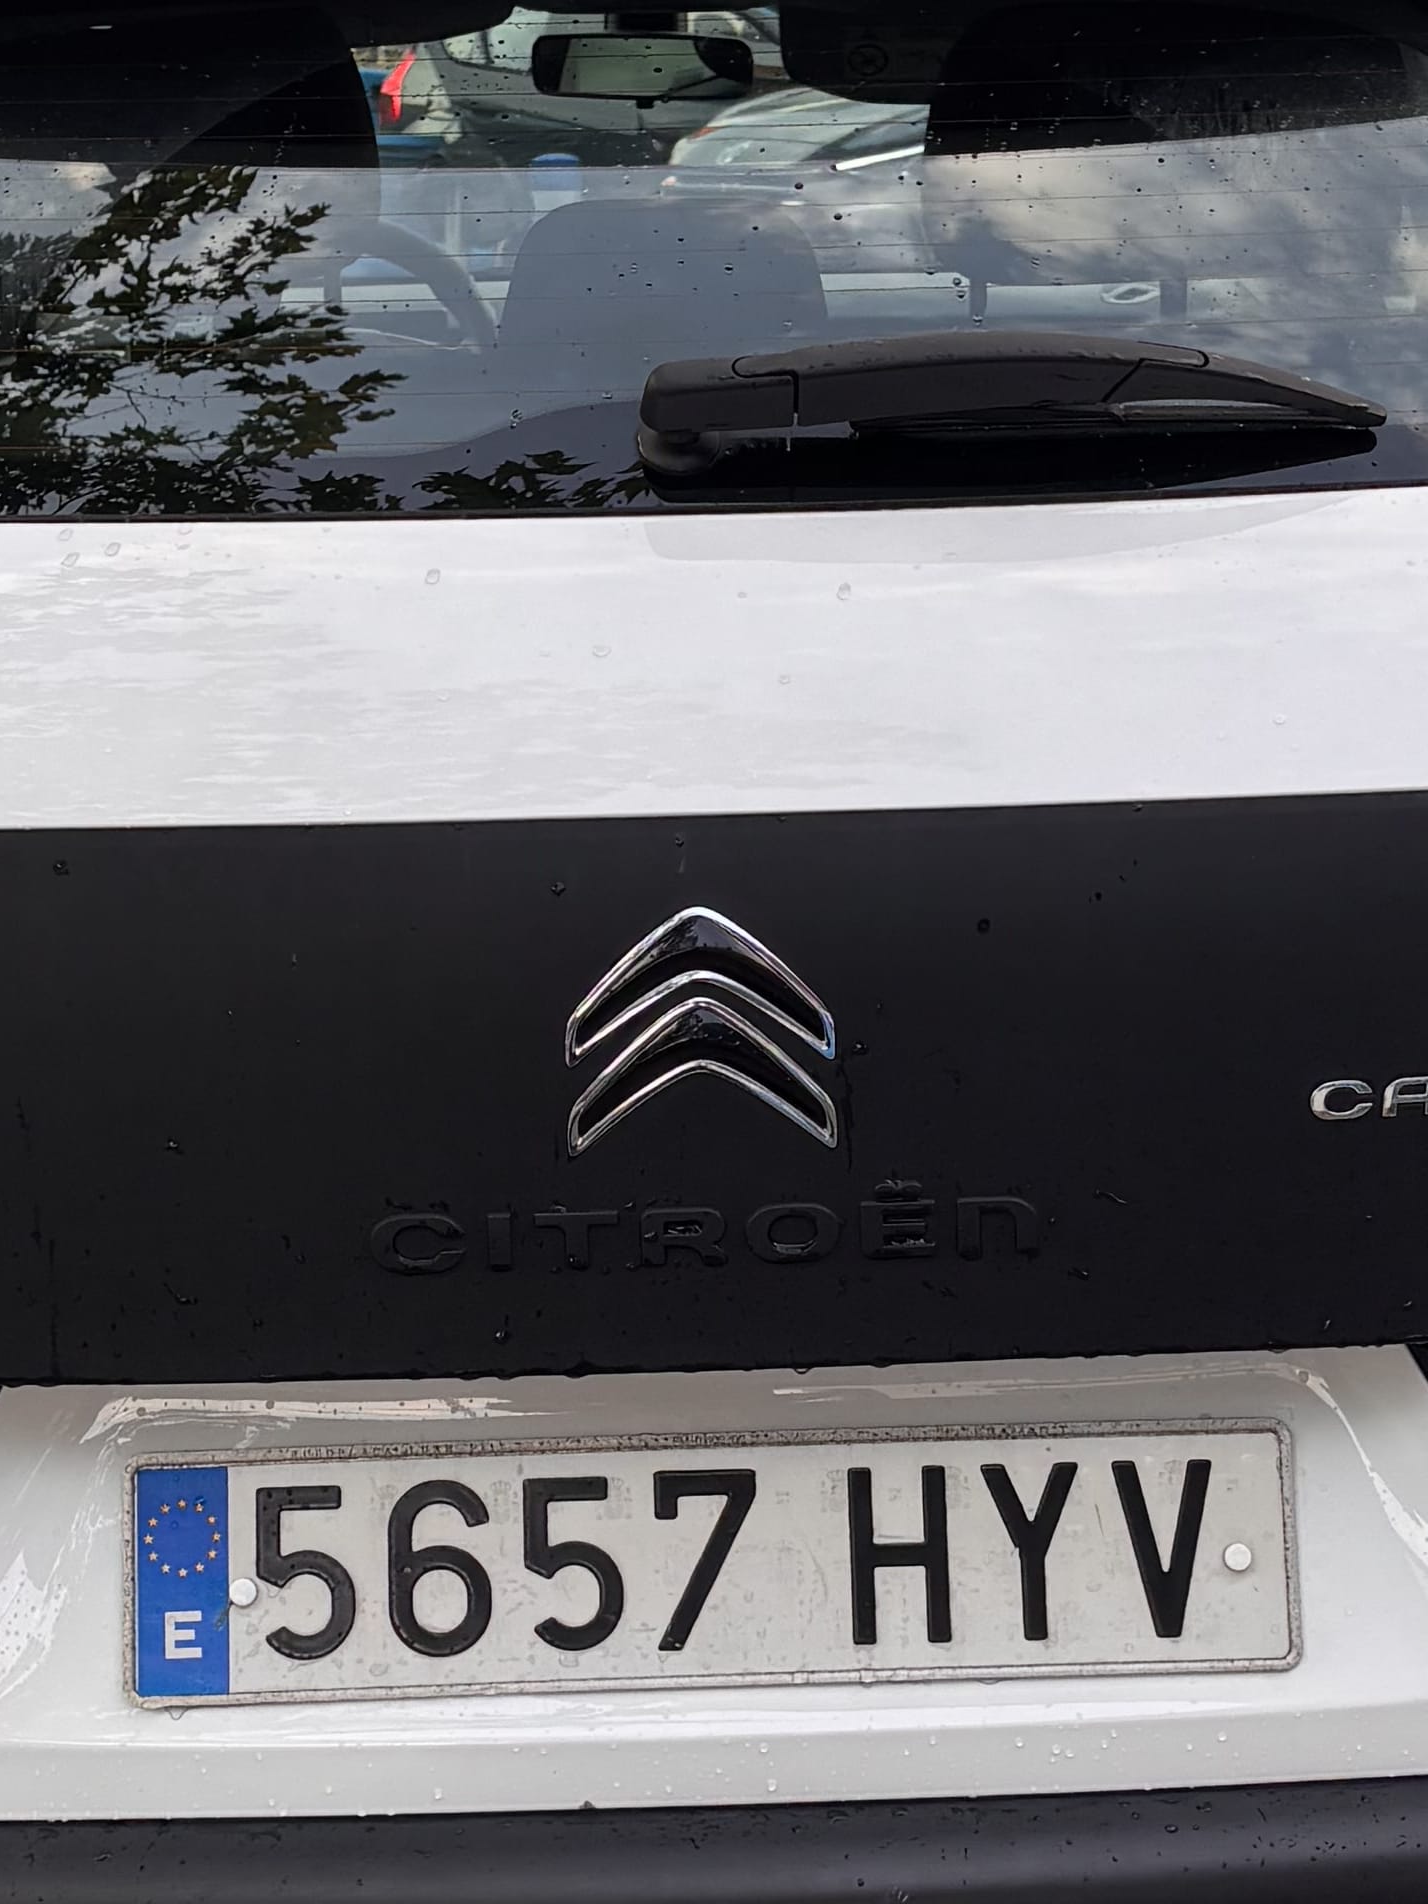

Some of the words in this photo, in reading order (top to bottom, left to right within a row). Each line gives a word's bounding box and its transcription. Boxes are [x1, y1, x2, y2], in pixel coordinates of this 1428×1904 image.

[372, 1179, 1040, 1274] CITROËN
[256, 1469, 757, 1659] 5657
[847, 1459, 1212, 1645] HYV
[164, 1610, 203, 1660] E
